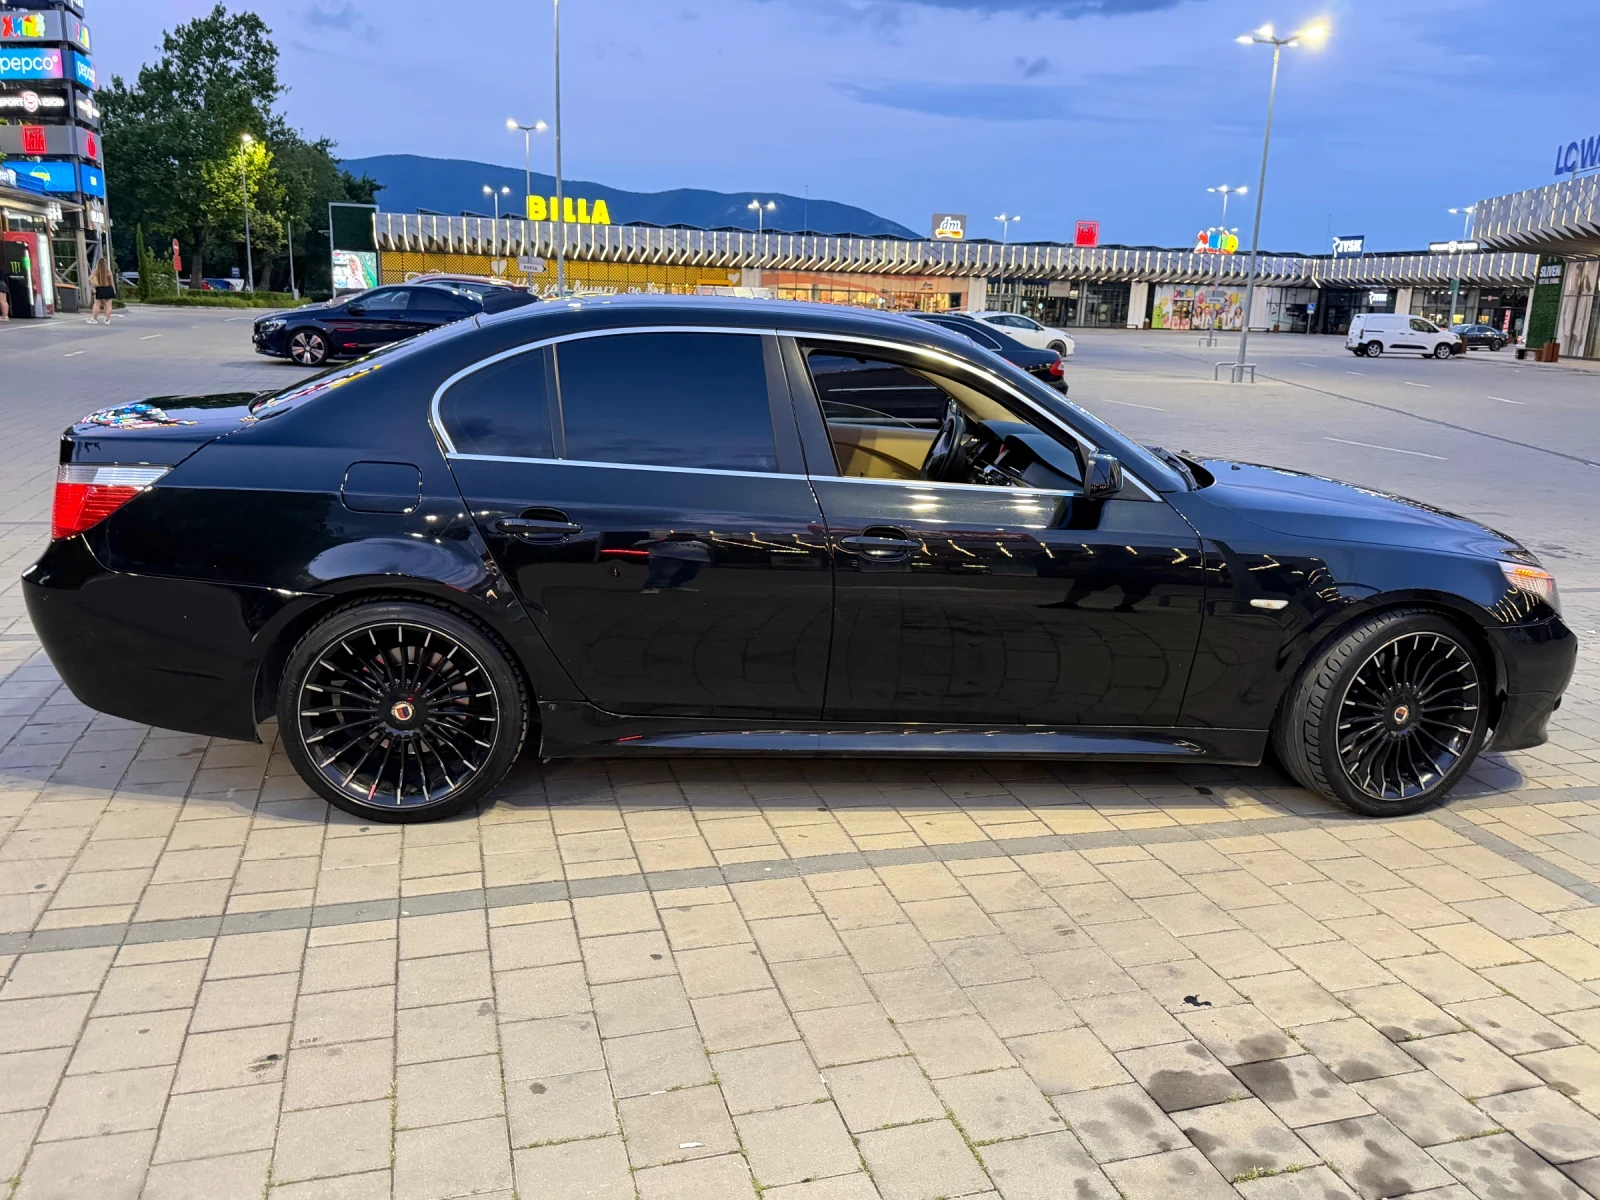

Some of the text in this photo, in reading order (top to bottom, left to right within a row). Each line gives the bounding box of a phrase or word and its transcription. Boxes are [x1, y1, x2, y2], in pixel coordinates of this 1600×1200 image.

[0, 57, 54, 74] pepco
[1554, 134, 1600, 175] LCW
[526, 195, 611, 224] BILLA
[940, 217, 961, 231] dm
[1337, 239, 1363, 253] JYSK
[1540, 265, 1562, 277] SLIVEN
